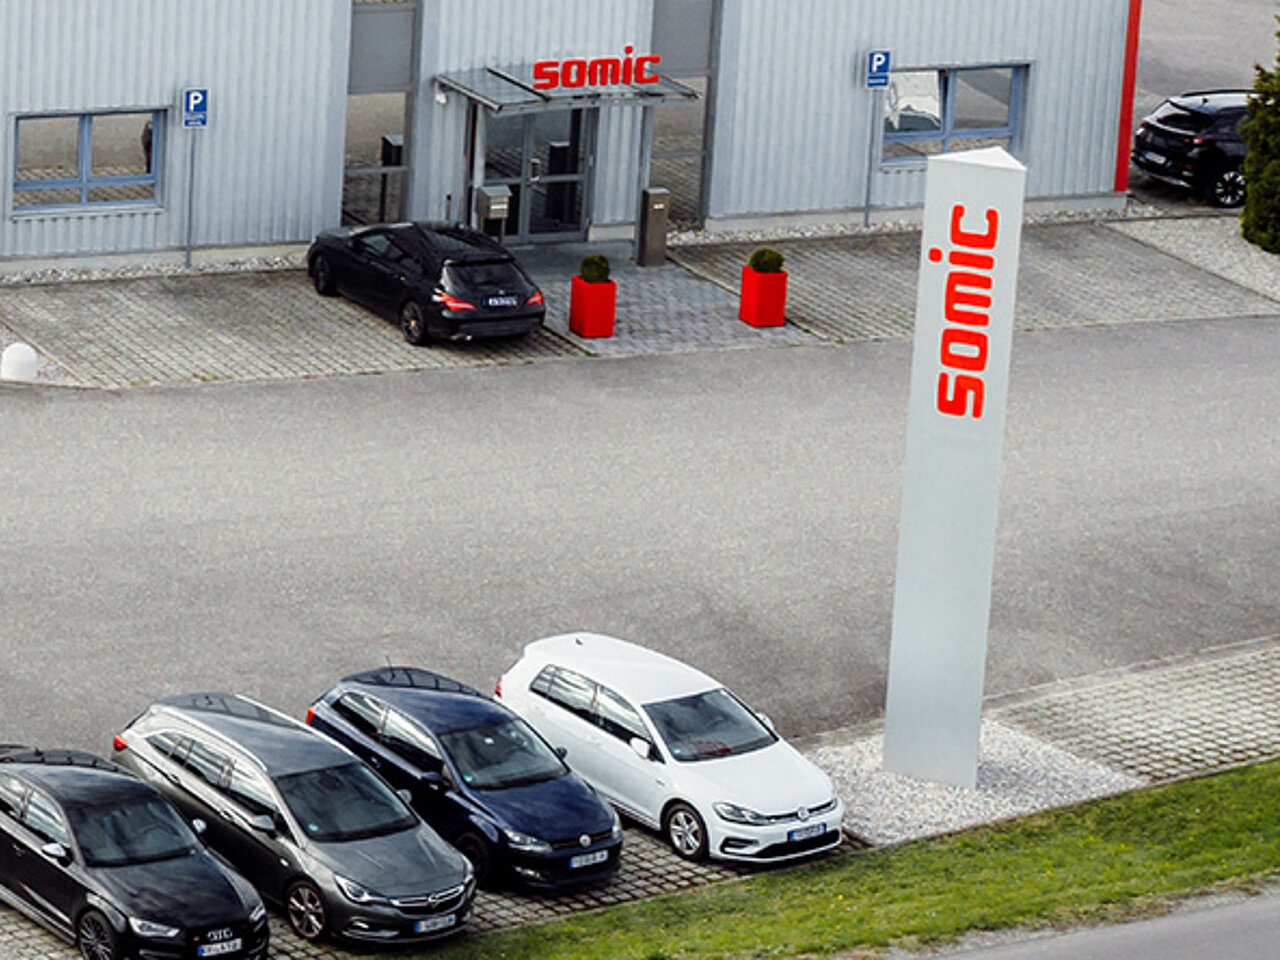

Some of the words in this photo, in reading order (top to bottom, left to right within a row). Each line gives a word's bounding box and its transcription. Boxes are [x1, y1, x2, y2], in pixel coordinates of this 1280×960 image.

[533, 45, 661, 89] somic
[873, 54, 886, 73] P
[189, 91, 203, 112] P
[928, 204, 999, 419] somic
